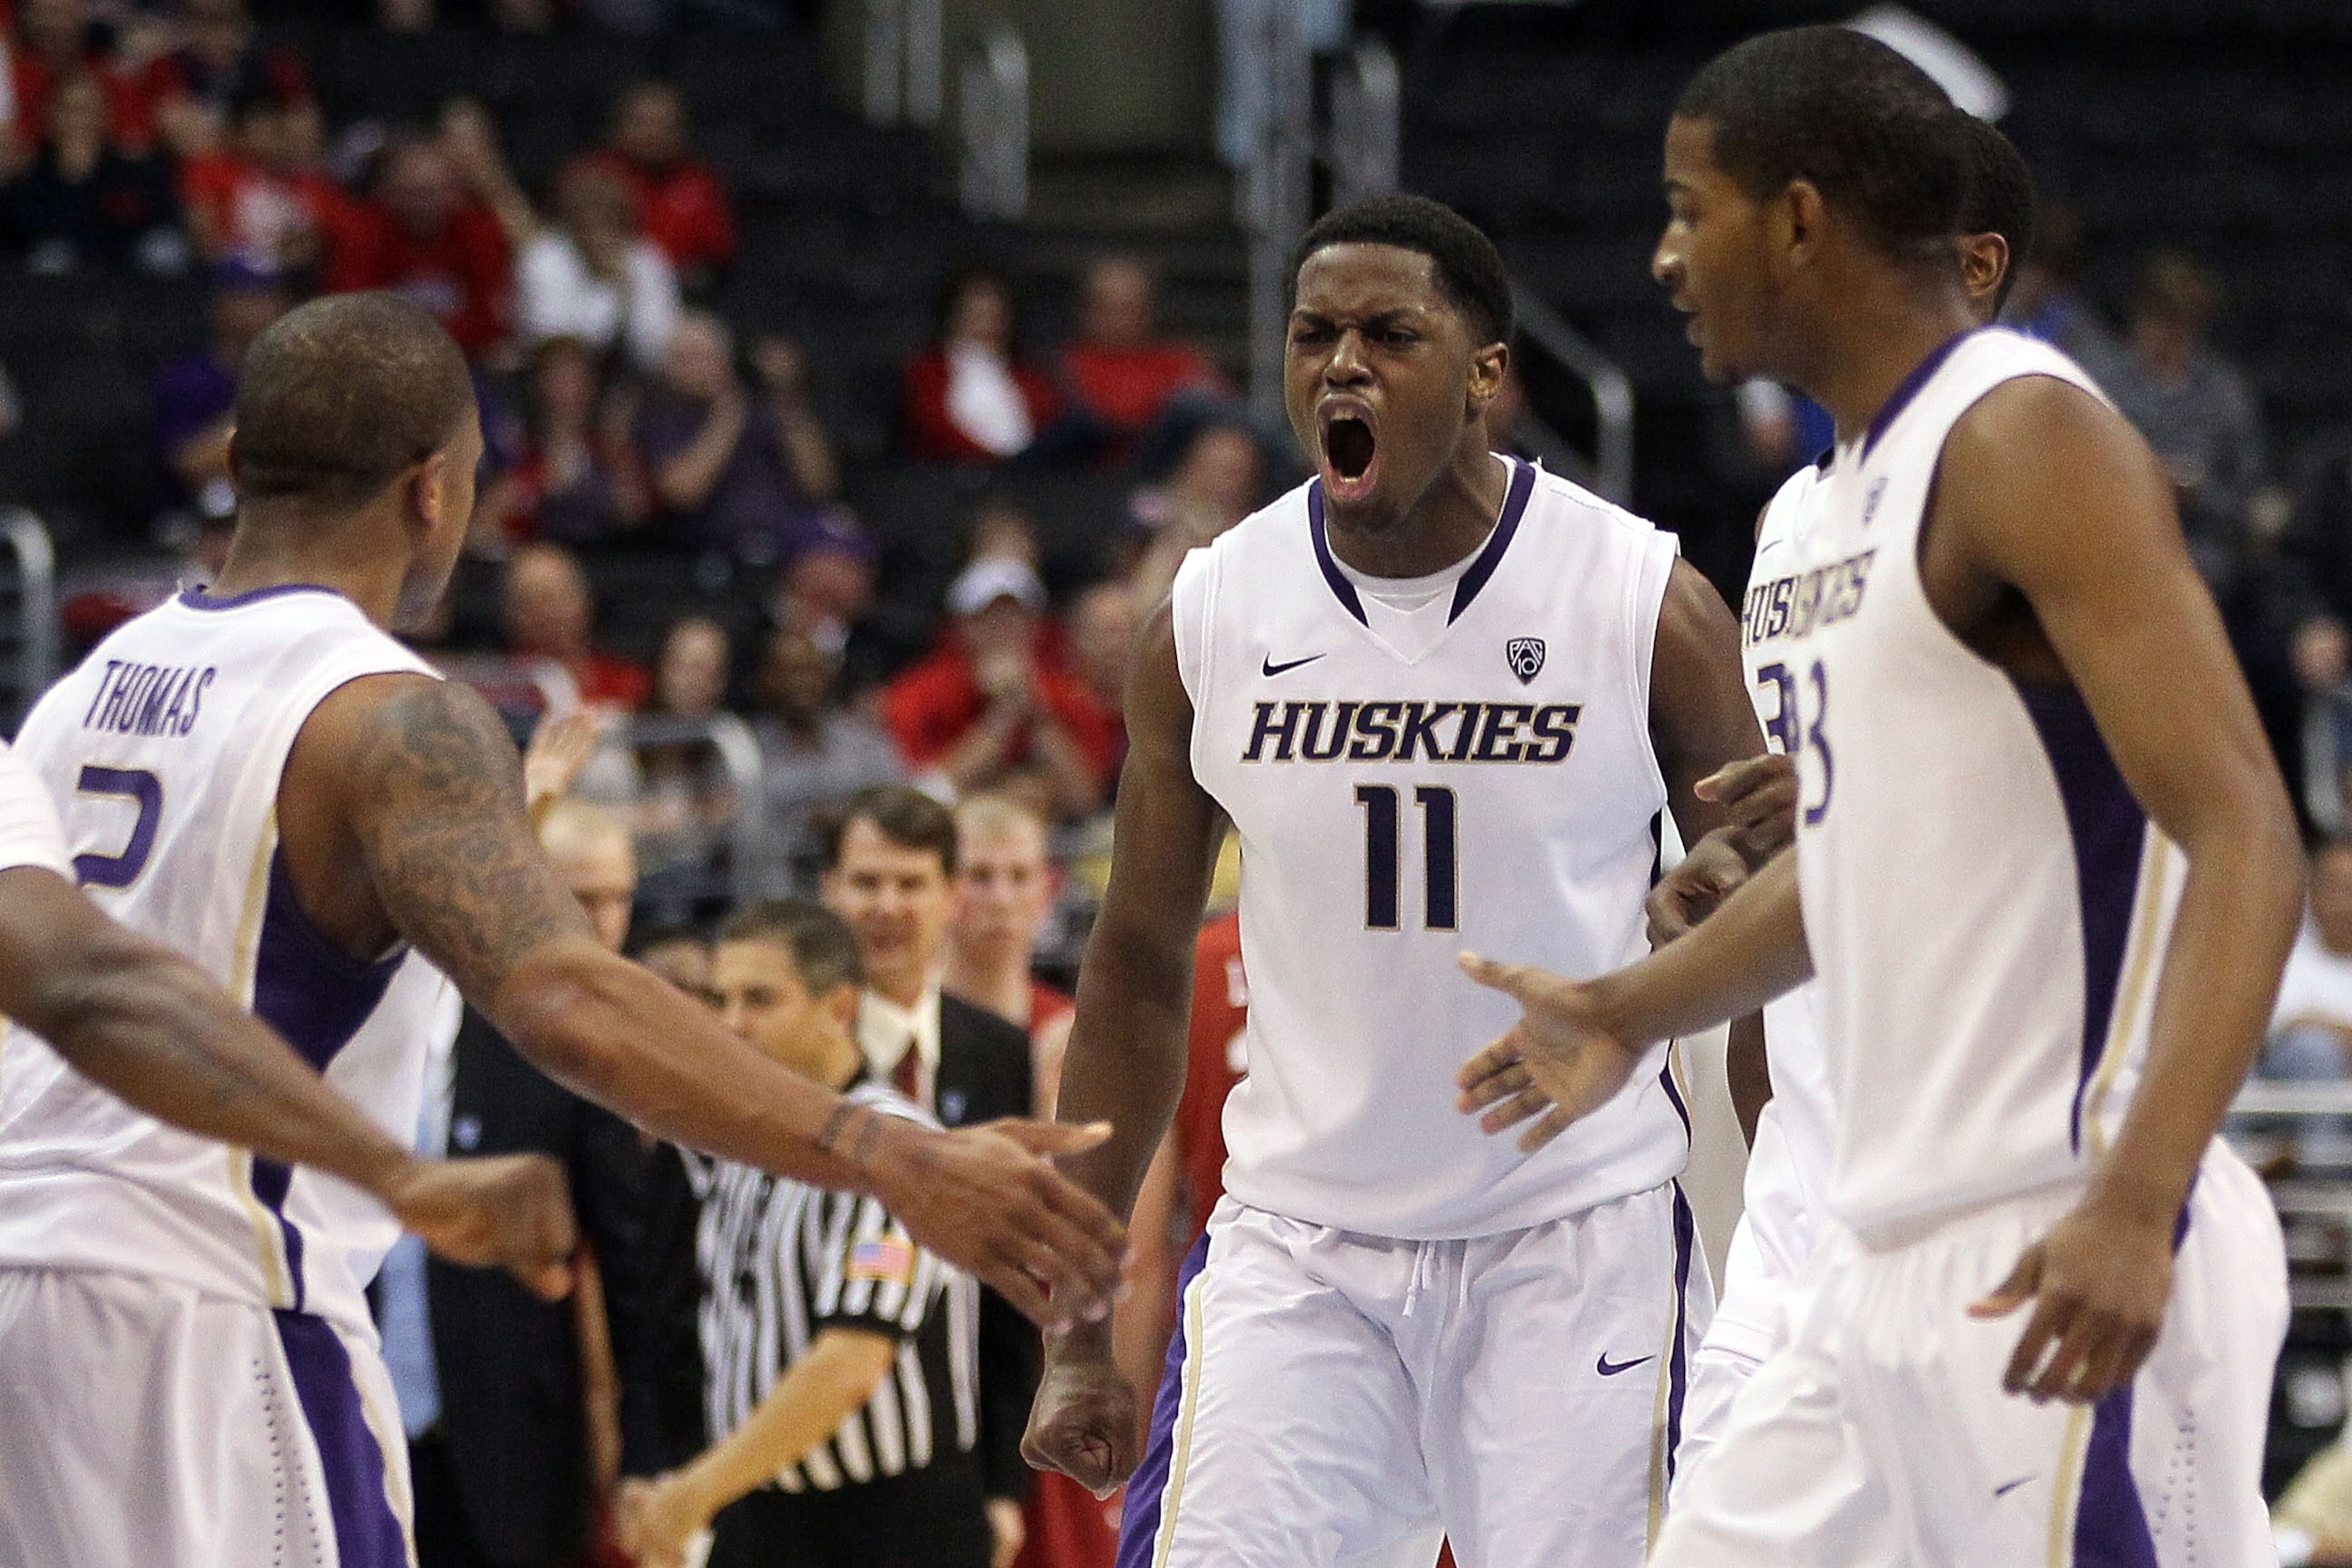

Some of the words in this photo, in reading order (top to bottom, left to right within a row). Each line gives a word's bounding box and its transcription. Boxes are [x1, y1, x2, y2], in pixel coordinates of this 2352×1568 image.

[83, 660, 216, 736] THOMAS
[1517, 657, 1538, 675] 10
[1240, 699, 1585, 765] HUSKIES
[72, 764, 163, 890] 2
[1352, 782, 1460, 932] 11
